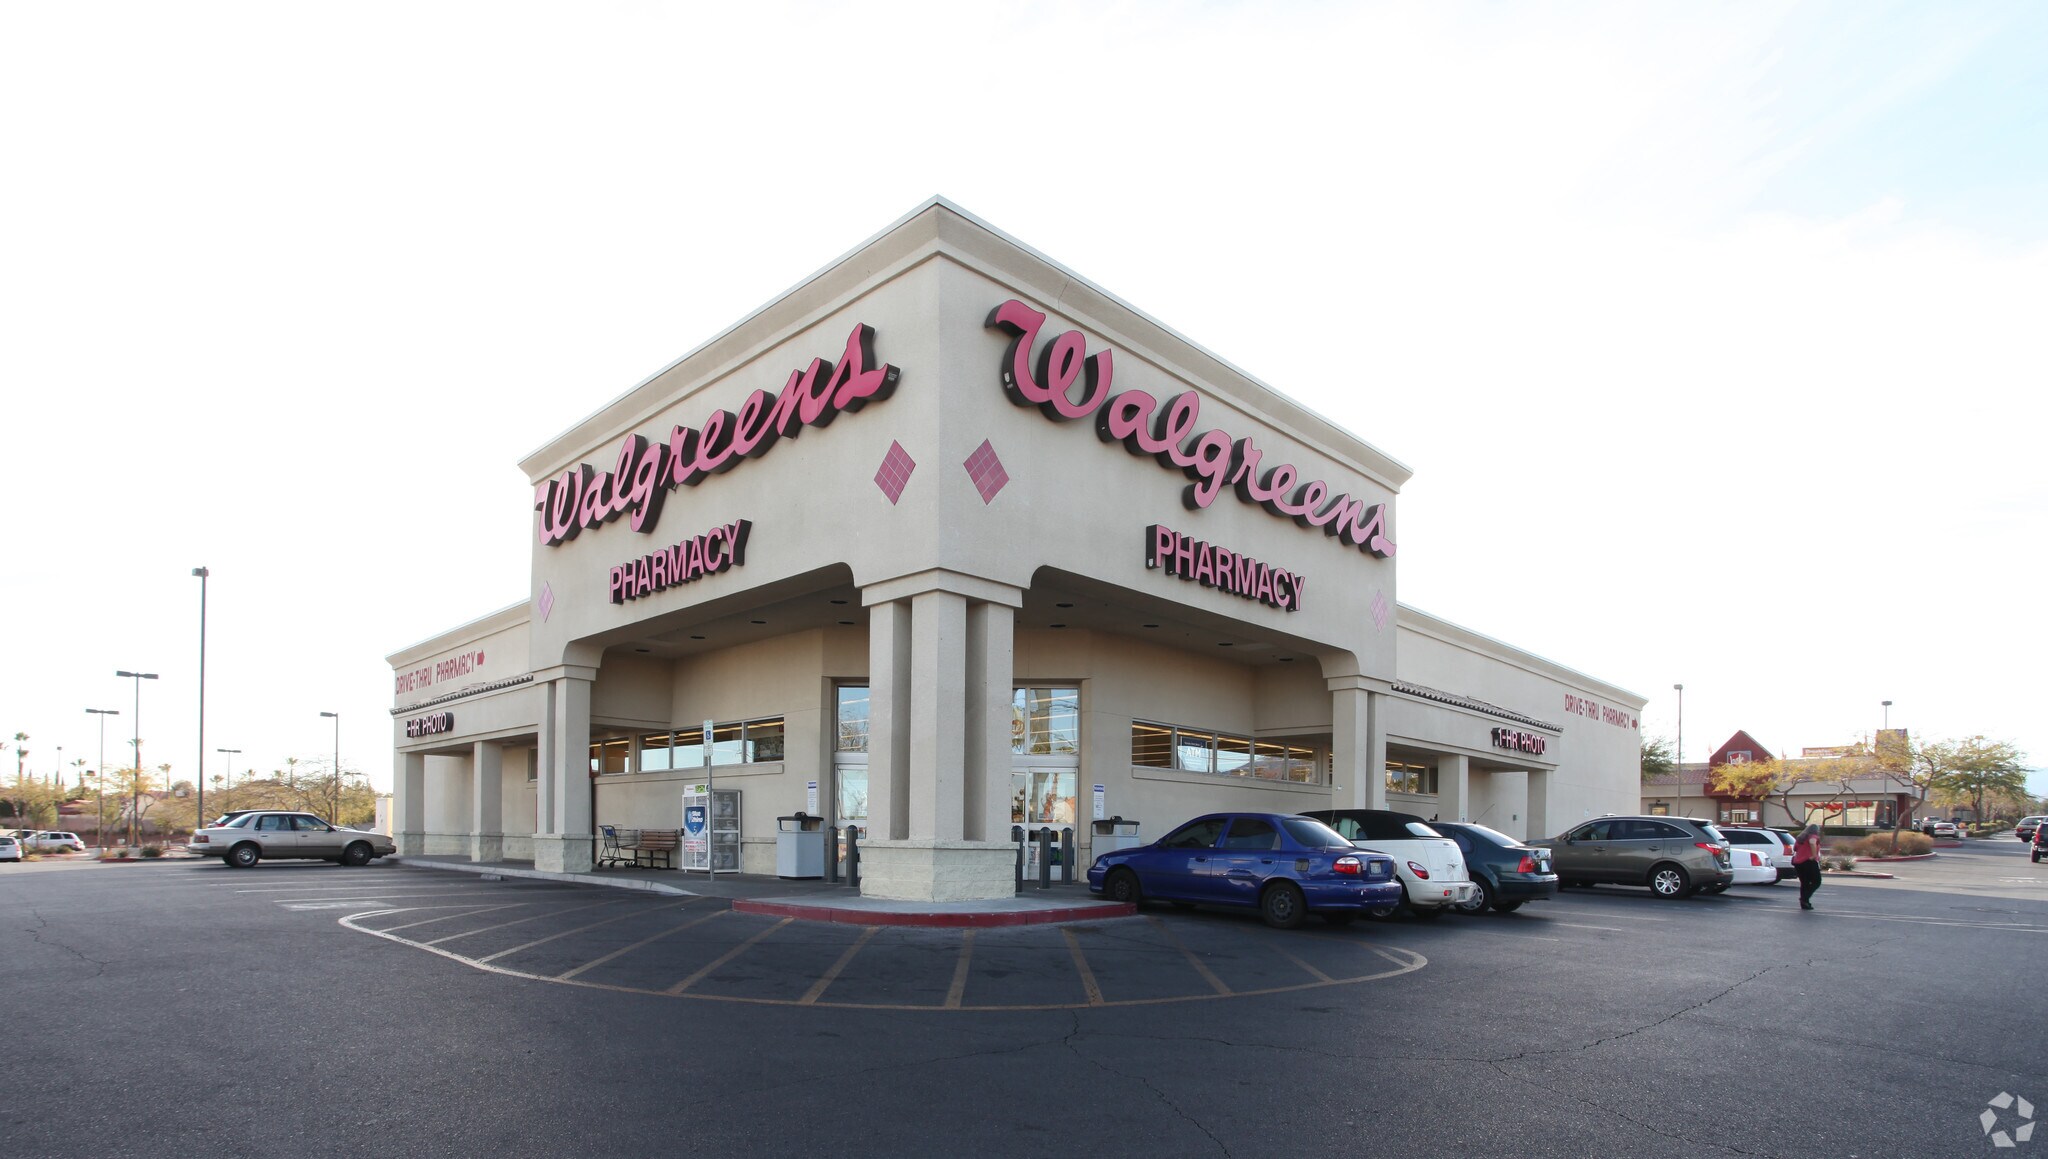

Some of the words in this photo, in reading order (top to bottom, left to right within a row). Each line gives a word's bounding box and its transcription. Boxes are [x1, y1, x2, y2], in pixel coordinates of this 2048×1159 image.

[535, 323, 890, 546] Walgreens
[996, 300, 1397, 558] Walgreens
[610, 519, 742, 604] PHARMACY
[1154, 525, 1306, 611] PHARMACY
[396, 666, 432, 695] DRIVE-THRU
[436, 651, 475, 683] PHARMACY
[422, 712, 446, 734] PHOTO
[1521, 732, 1546, 755] PHOTO
[1564, 694, 1600, 720] DRIVE-THRU
[1602, 705, 1631, 729] PHARMACY
